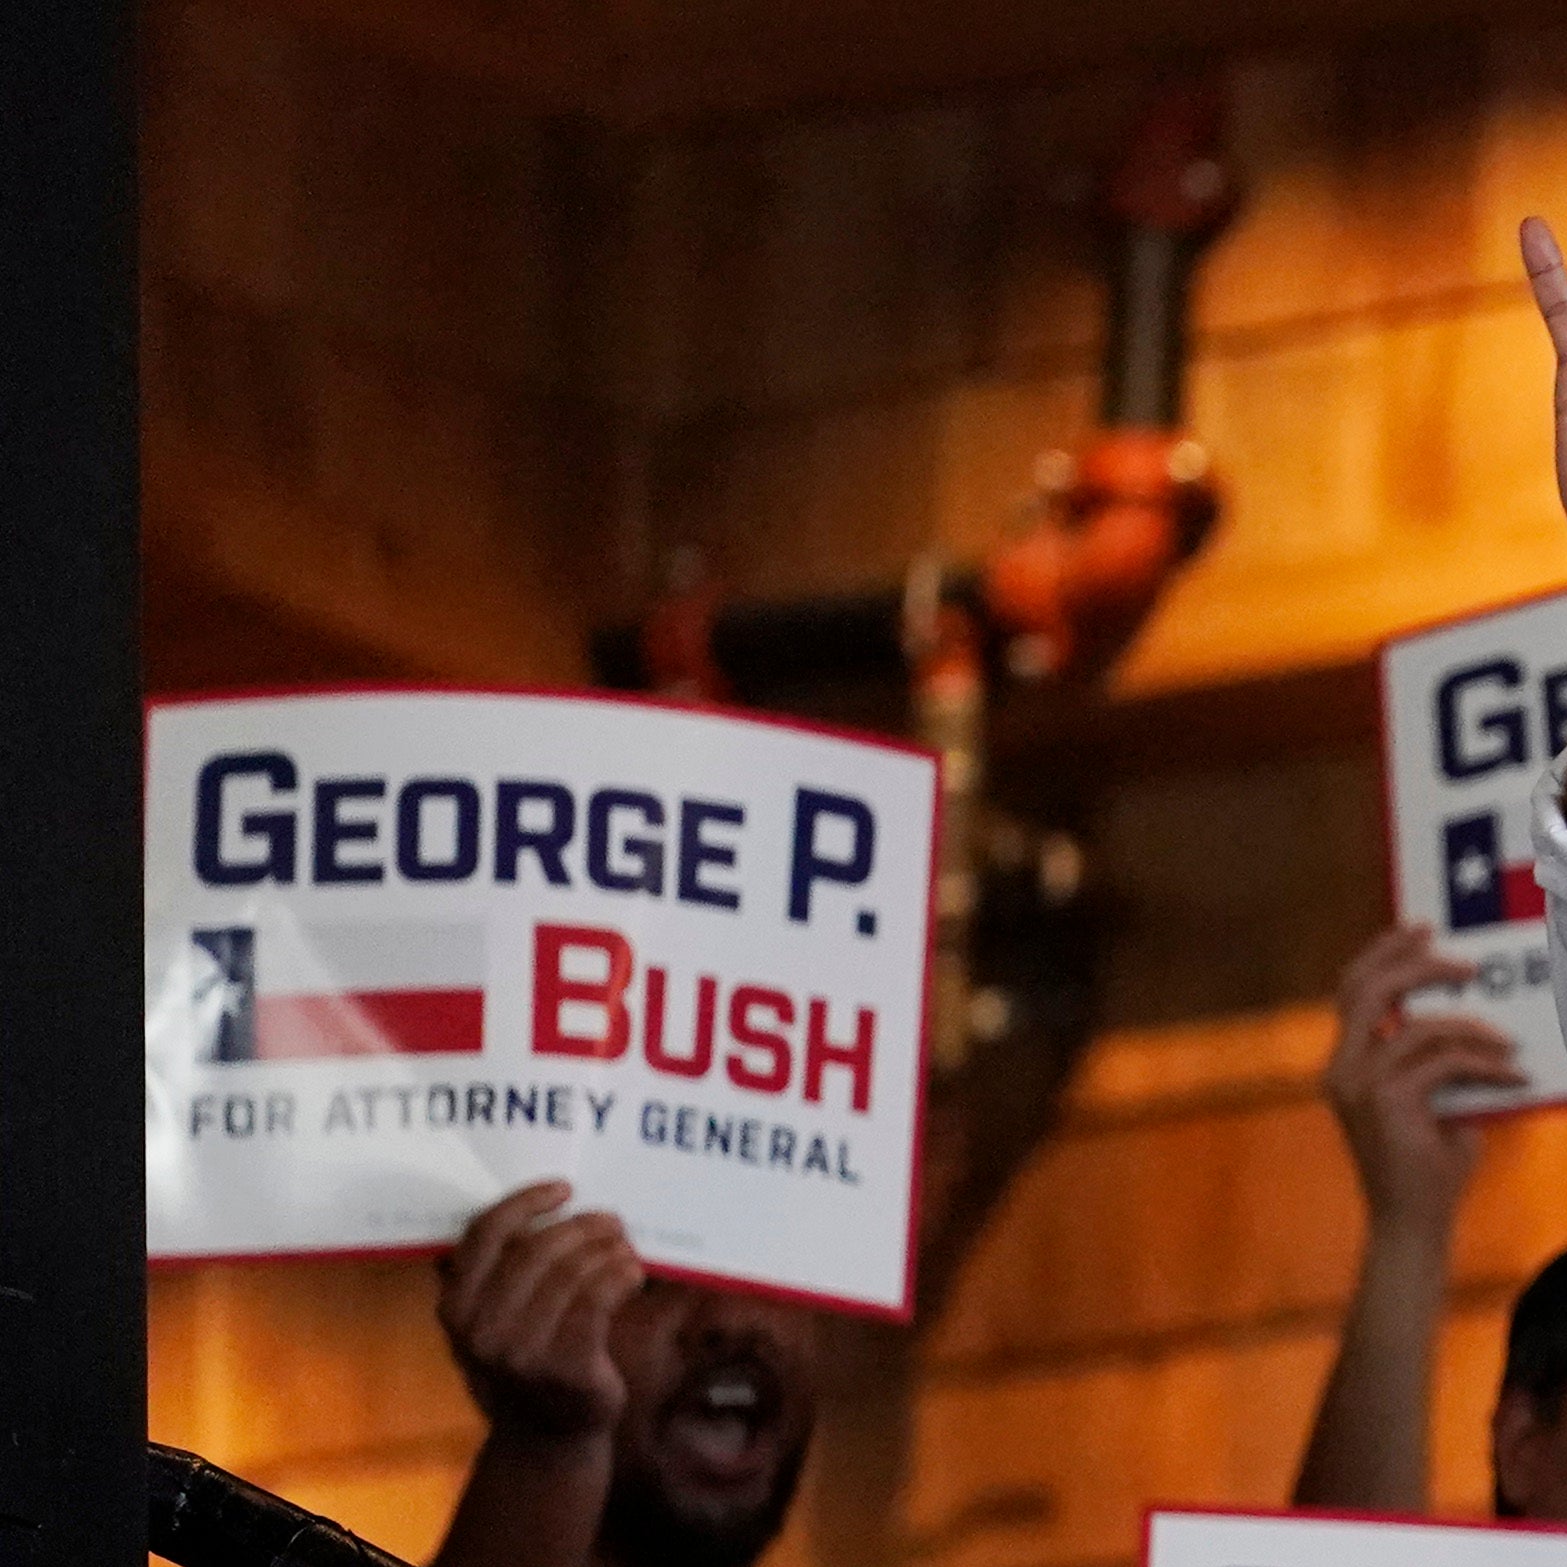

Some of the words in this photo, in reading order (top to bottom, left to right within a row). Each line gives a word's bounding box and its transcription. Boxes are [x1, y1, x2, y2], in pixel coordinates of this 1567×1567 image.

[194, 751, 745, 908] GEORGE
[788, 788, 880, 936] P.
[530, 922, 877, 1115] BUSH
[188, 1091, 298, 1139] FOR
[324, 1084, 618, 1134] ATTORNEY
[641, 1103, 862, 1184] GENERAL
